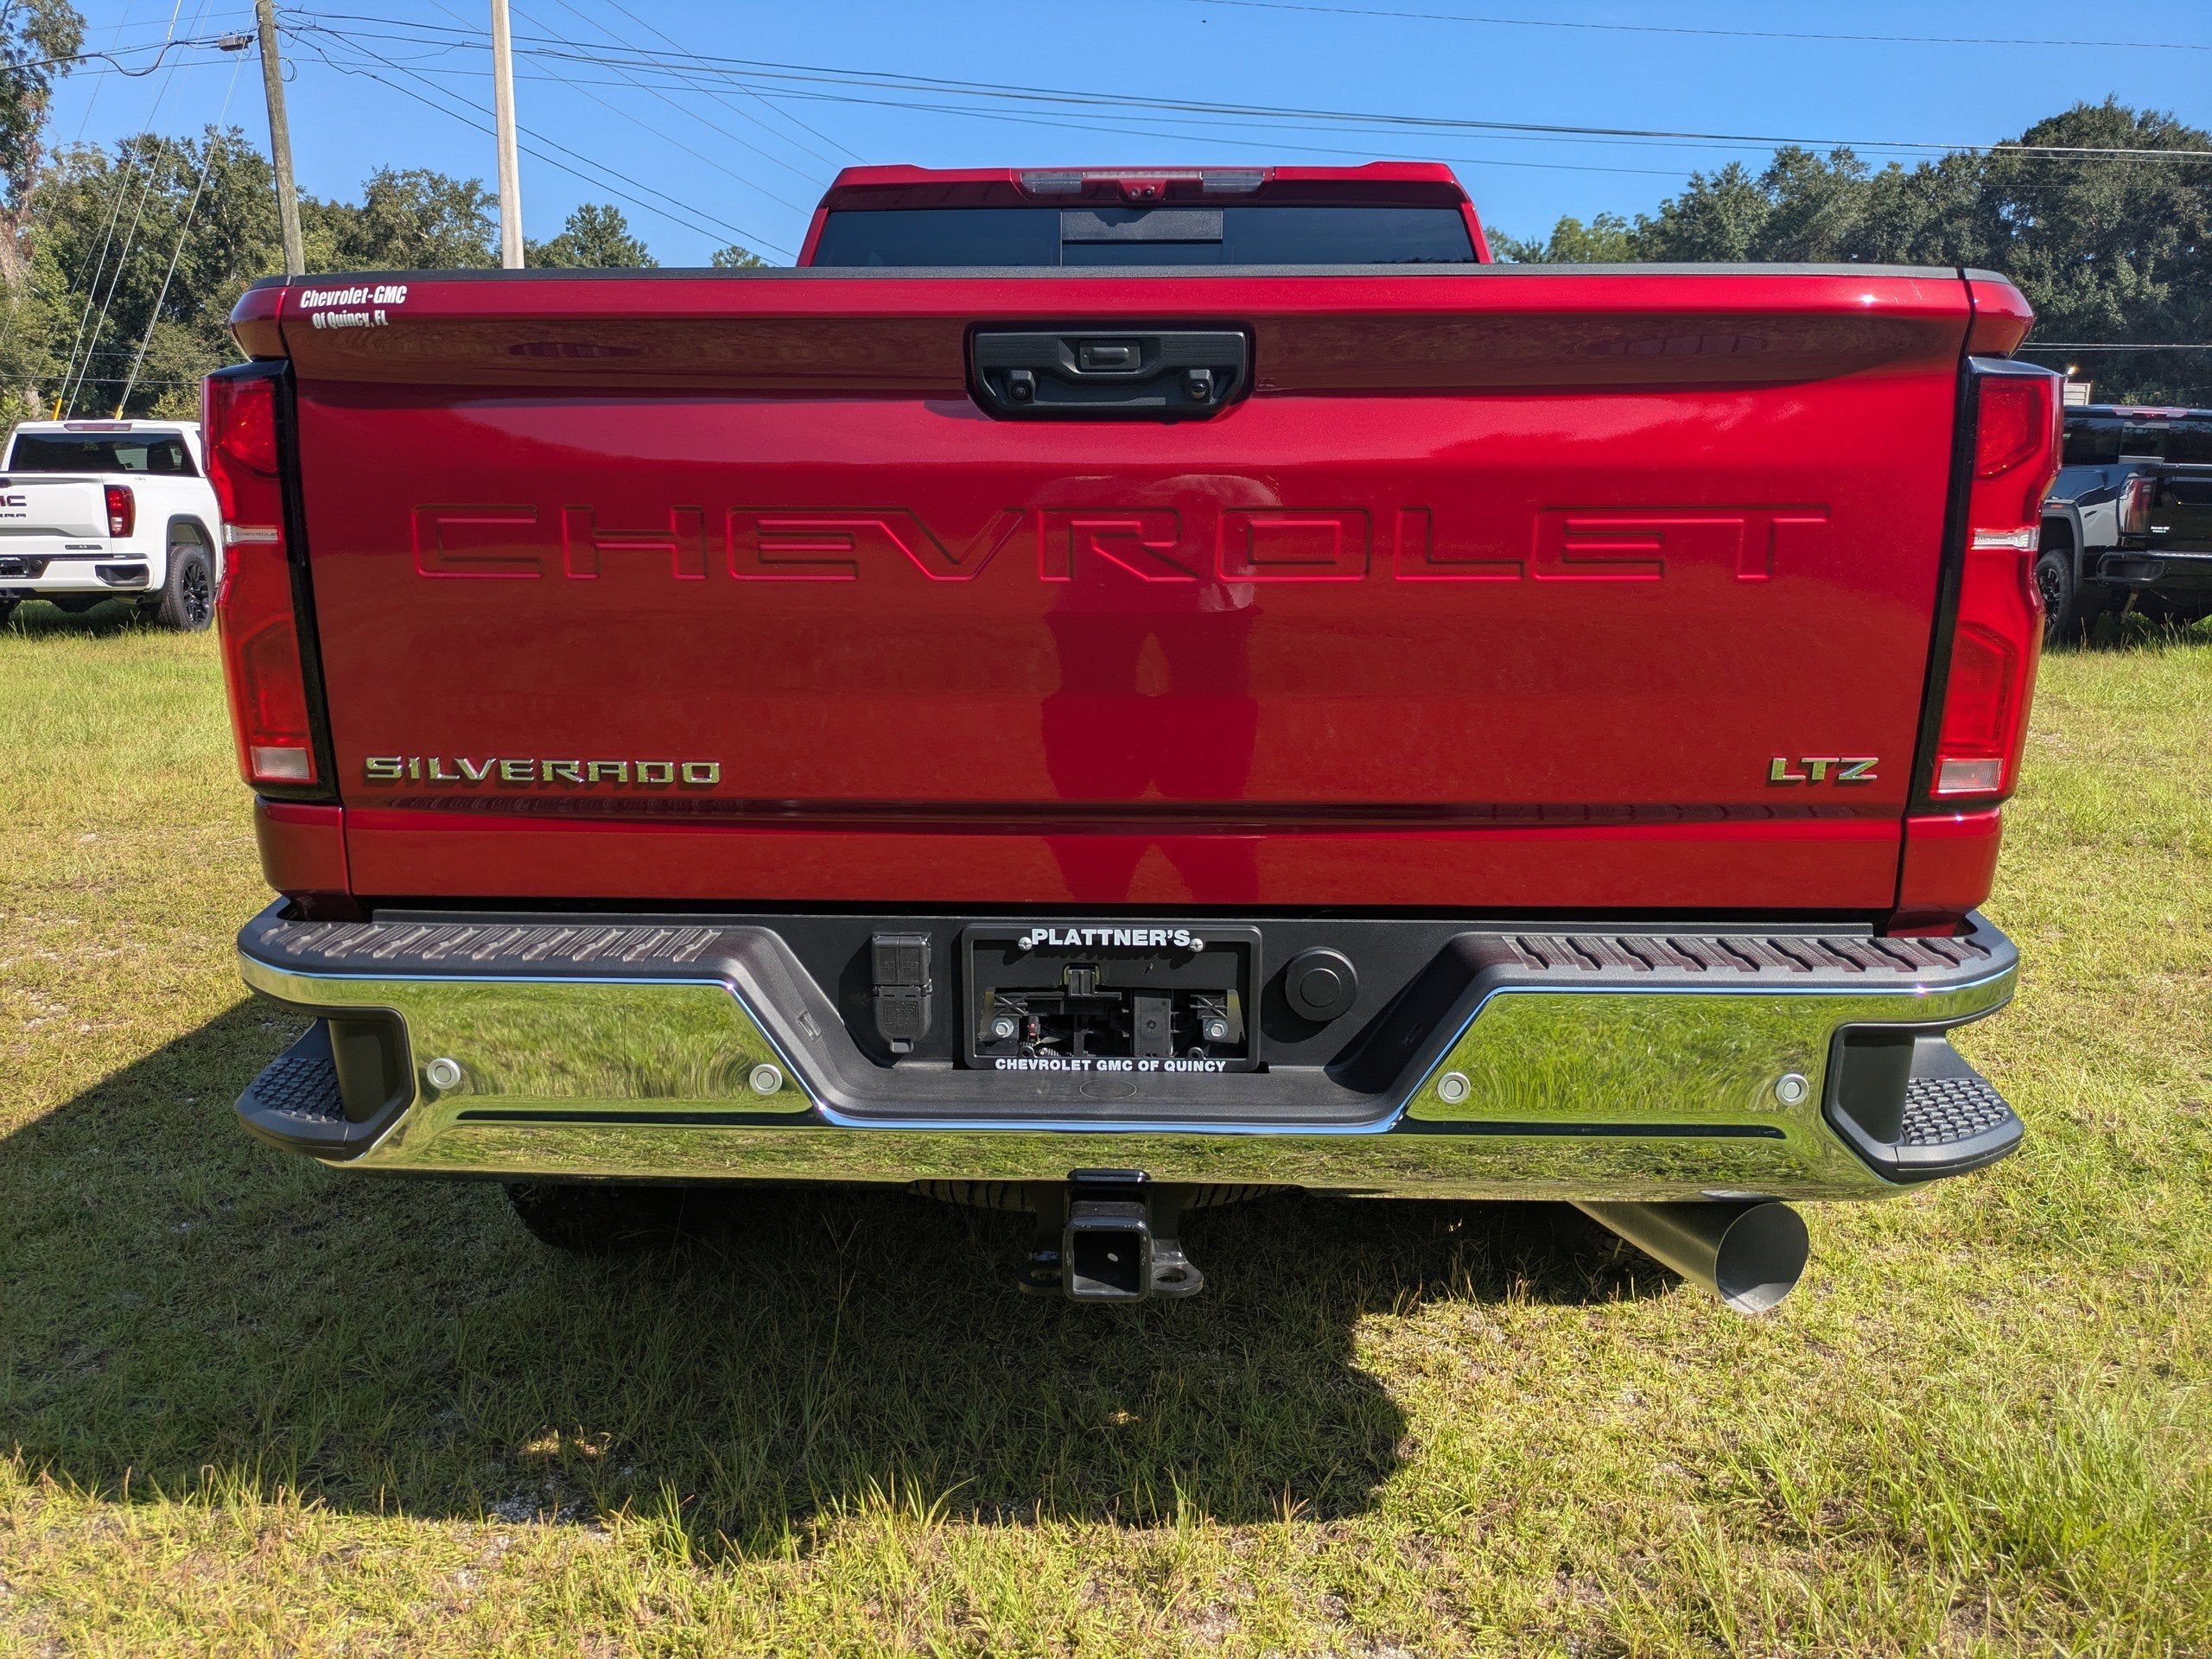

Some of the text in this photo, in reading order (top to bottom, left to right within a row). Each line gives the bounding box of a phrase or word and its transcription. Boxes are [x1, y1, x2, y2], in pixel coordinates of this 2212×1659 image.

[300, 285, 408, 308] Chevrolet-GMC
[313, 309, 389, 328] Of Quincy, FL
[0, 496, 27, 506] C
[410, 505, 1831, 581] CHEVROLET
[365, 756, 721, 784] SILVERADO
[1771, 757, 1879, 780] LTZ
[1031, 928, 1191, 947] PLATTNER'S
[995, 1058, 1226, 1072] CHEVROLET GMC OF QUINCY
